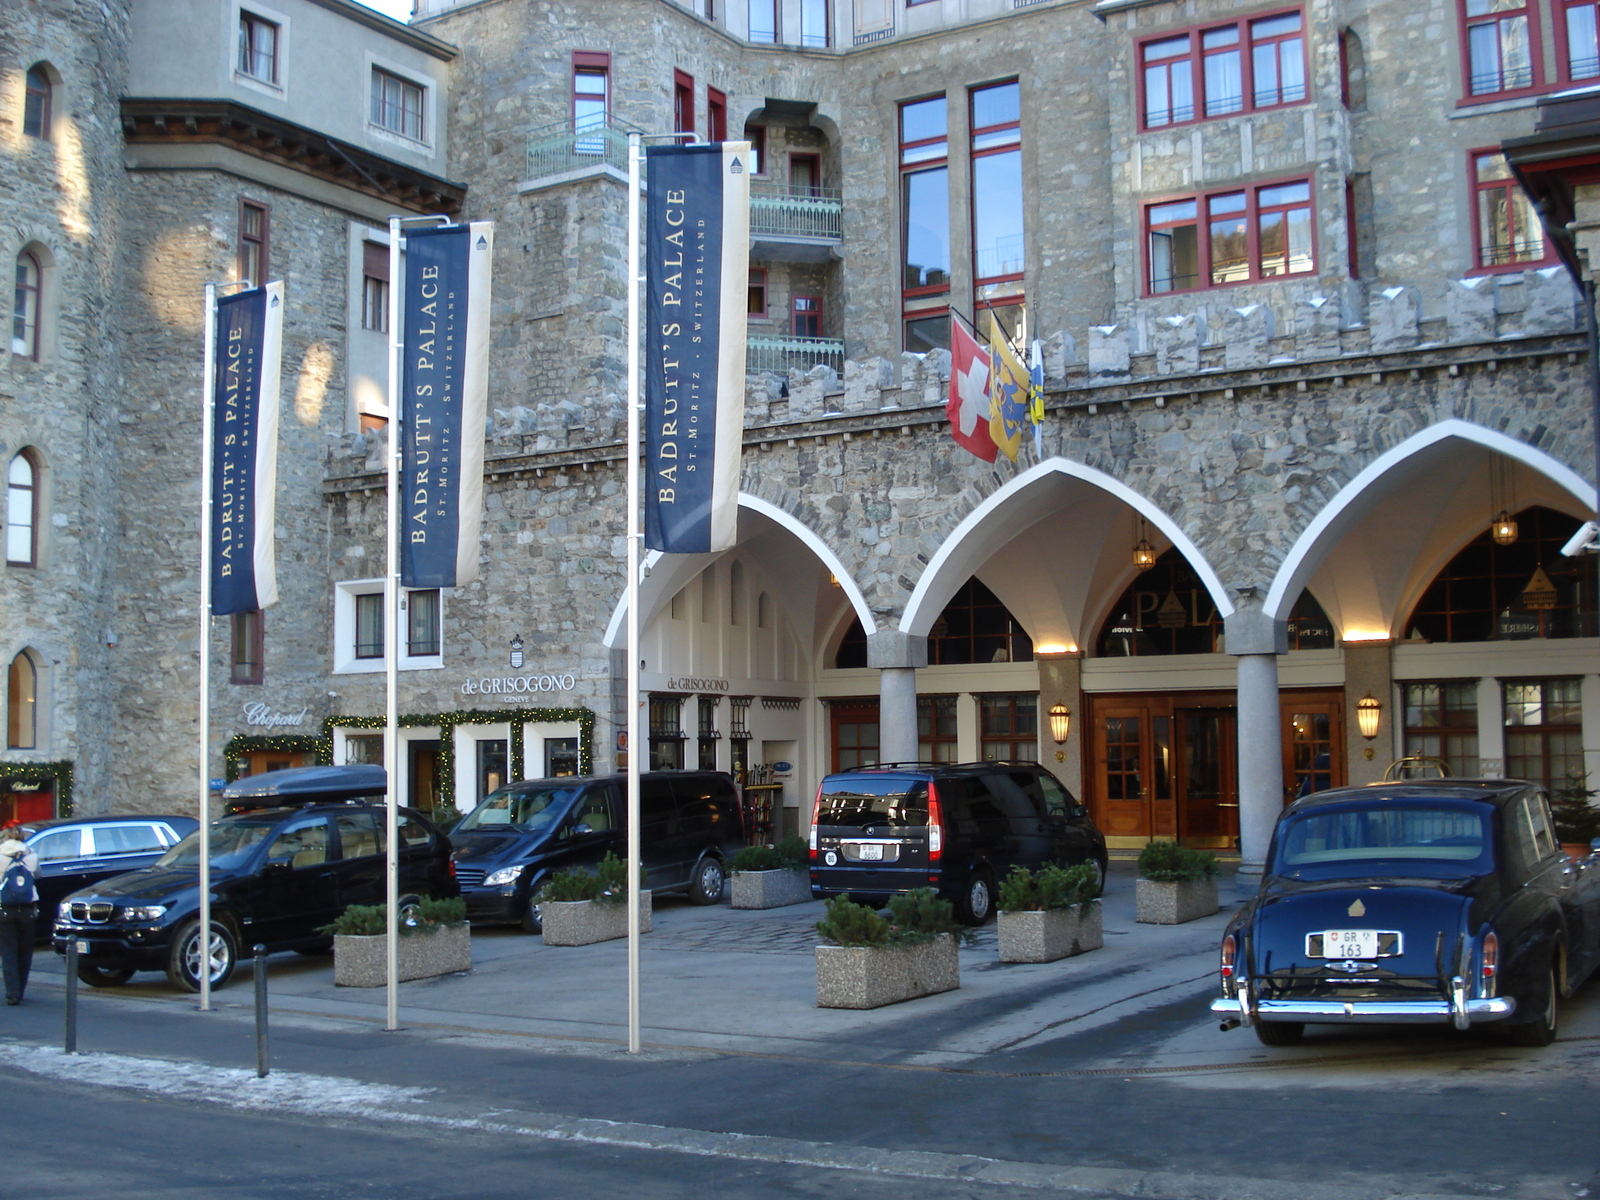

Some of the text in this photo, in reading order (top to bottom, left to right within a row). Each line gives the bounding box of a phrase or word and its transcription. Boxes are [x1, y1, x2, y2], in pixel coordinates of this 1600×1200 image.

[692, 218, 706, 343] SWITZERLAND
[442, 291, 455, 402] SWITZERLAND
[658, 188, 685, 504] BADRUTT'S PALACE
[241, 347, 254, 447] SWITZERLAND
[411, 265, 439, 544] BADRUTT'S PALACE
[221, 327, 242, 578] BADRUTT'S PALACE
[243, 701, 308, 730] Chopard
[461, 674, 575, 695] de GRISOGONO
[667, 677, 730, 692] de GRISOGONO
[1340, 943, 1362, 957] 163
[1344, 932, 1357, 942] GR
